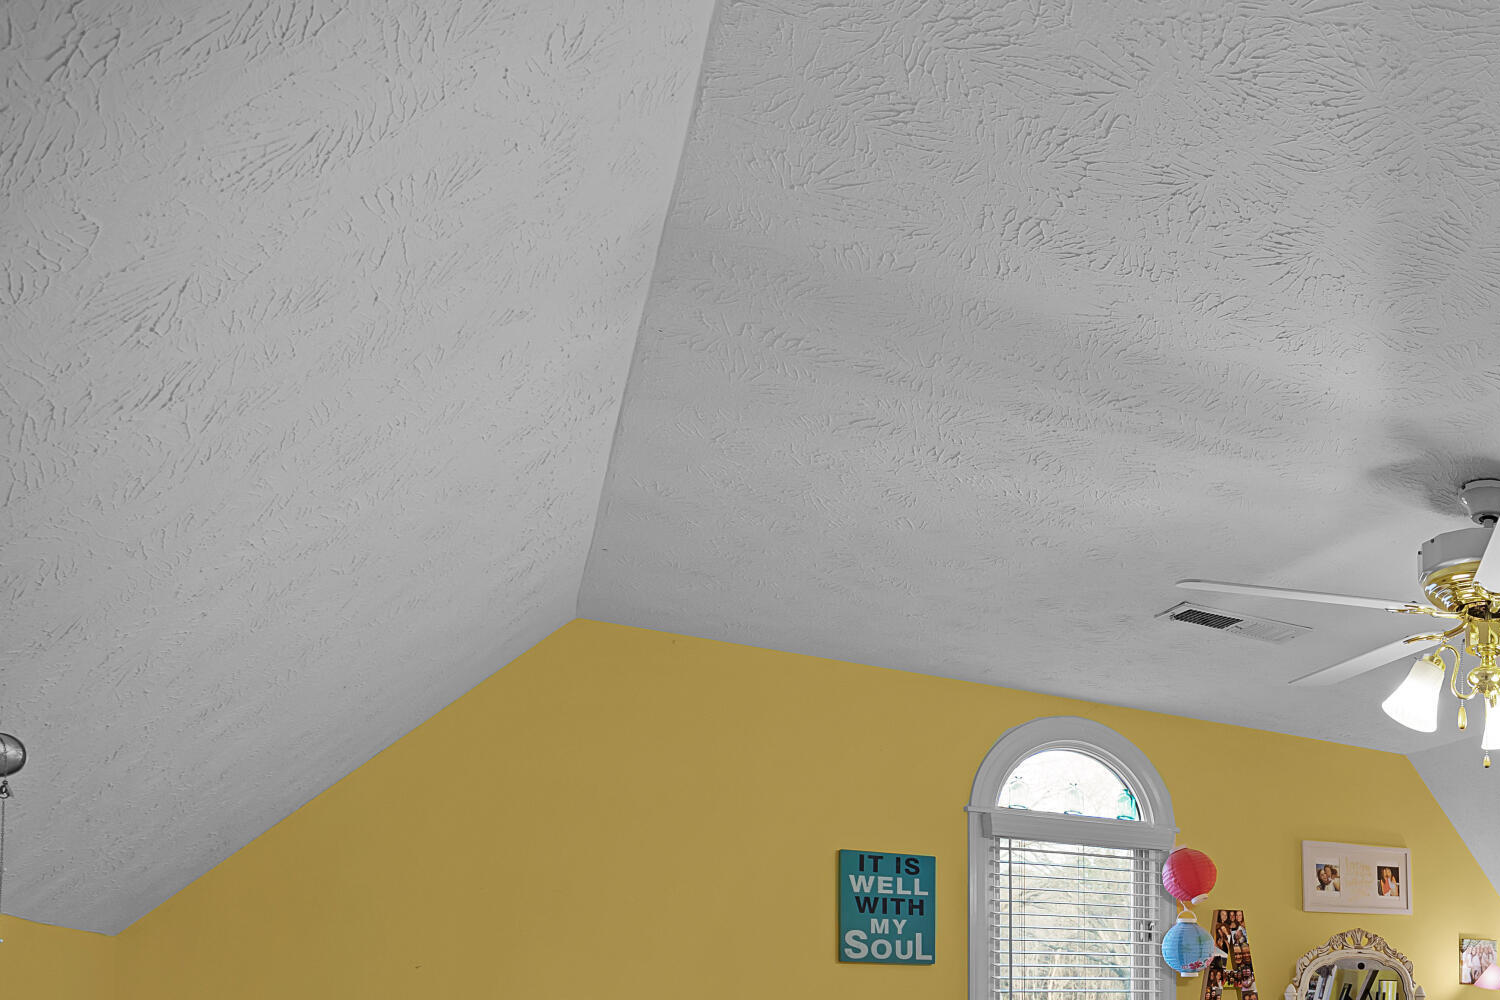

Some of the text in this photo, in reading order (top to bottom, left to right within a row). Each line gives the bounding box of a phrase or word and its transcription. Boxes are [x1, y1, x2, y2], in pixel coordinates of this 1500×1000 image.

[859, 854, 920, 875] IT IS
[848, 874, 929, 896] WELL
[855, 895, 925, 916] WITH
[870, 918, 908, 935] MY
[844, 929, 933, 961] SOUL
